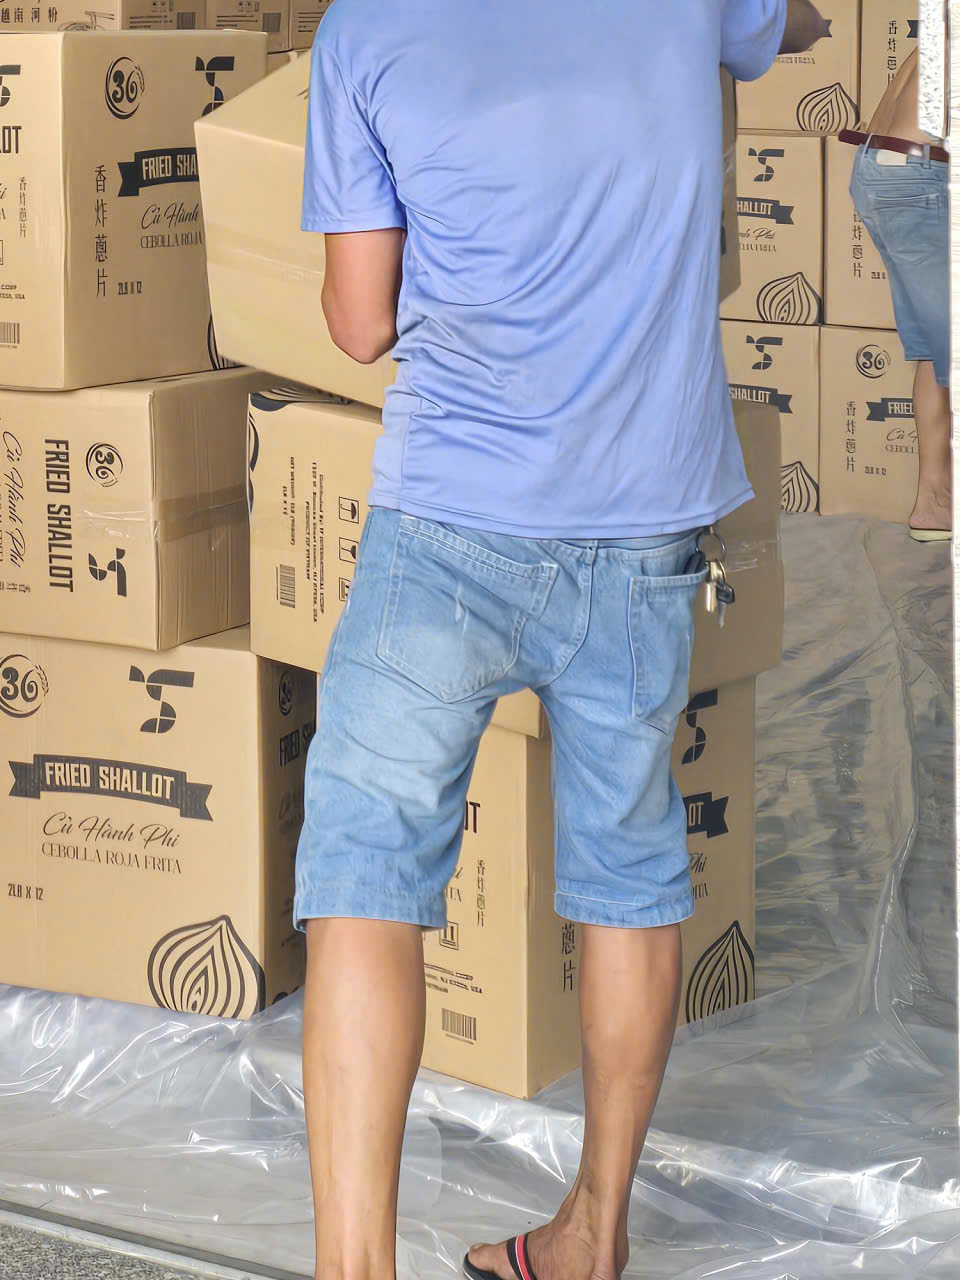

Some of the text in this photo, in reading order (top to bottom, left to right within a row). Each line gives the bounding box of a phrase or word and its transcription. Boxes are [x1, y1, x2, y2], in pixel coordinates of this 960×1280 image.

[112, 70, 138, 104] 36
[142, 155, 172, 180] FRIED
[737, 200, 773, 215] HALLOT
[862, 352, 884, 370] 36
[729, 388, 771, 404] SHALLOT
[95, 447, 116, 480] 36
[44, 439, 73, 592] FRIED SHALLOT
[1, 667, 38, 701] 36
[45, 762, 175, 800] FRIED SHALLOT
[42, 811, 72, 836] Củ
[78, 815, 136, 844] Hành
[42, 841, 182, 874] CEBOLLA ROJA FRITA
[8, 883, 44, 901] 2LB X 12
[562, 922, 576, 992] 蔥片
